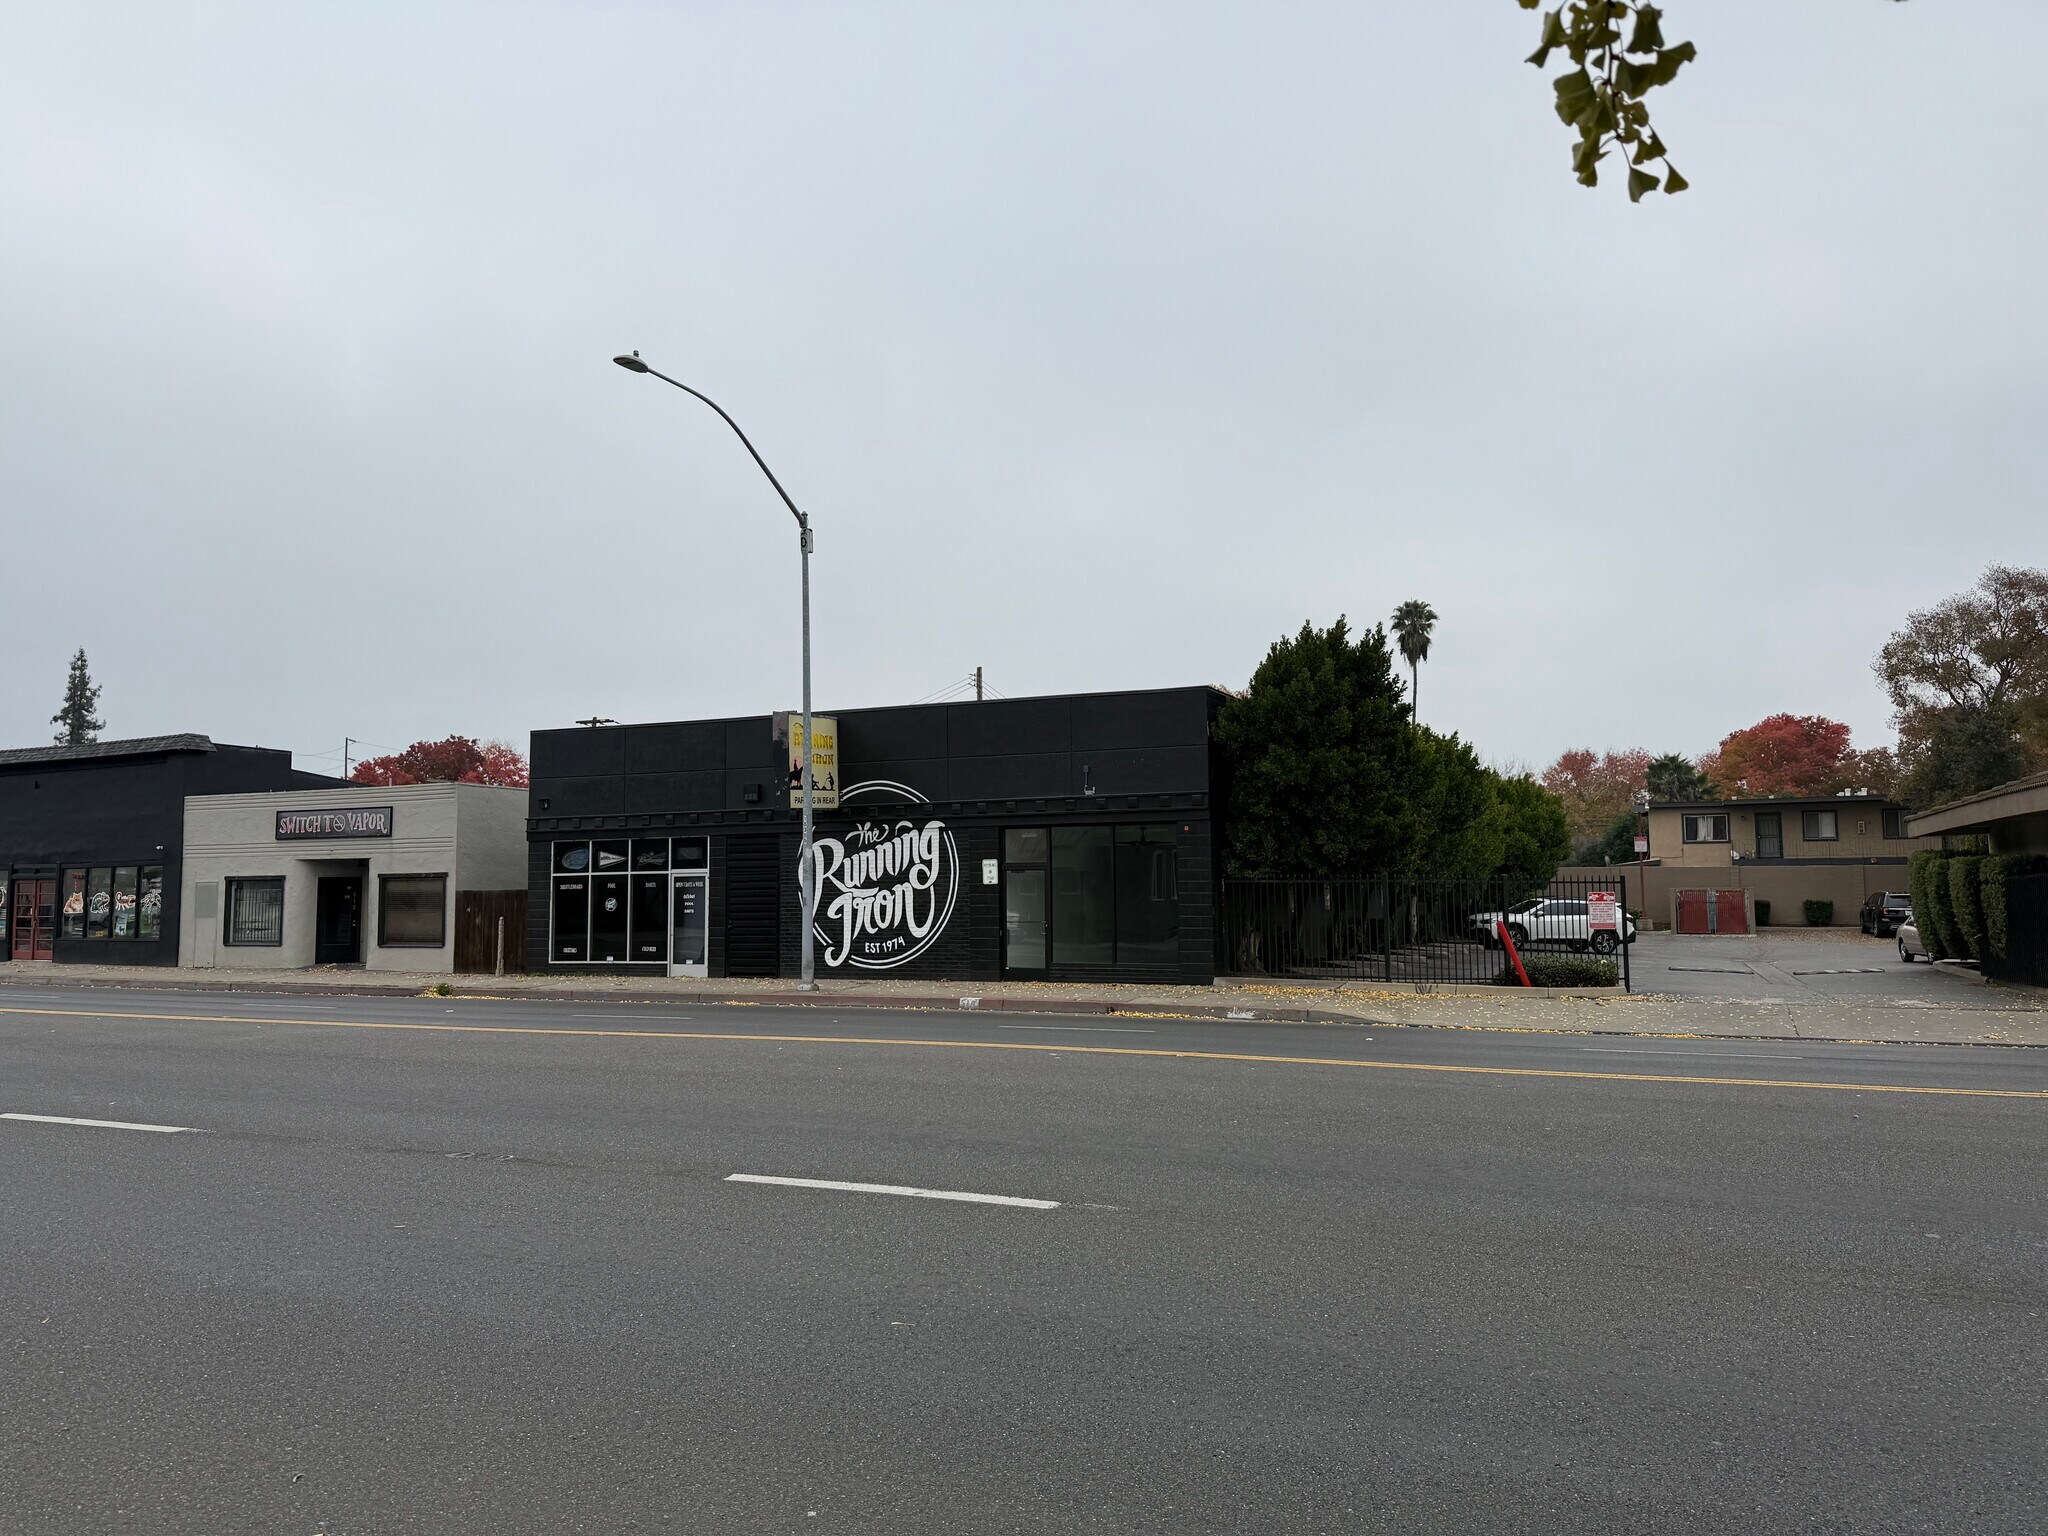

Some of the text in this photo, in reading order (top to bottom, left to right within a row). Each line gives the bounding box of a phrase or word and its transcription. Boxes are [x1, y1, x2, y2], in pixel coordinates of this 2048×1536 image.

[793, 732, 834, 749] RNING
[822, 797, 836, 805] REAR
[279, 815, 321, 834] SWITCH
[346, 811, 388, 834] VAPOR
[865, 935, 906, 953] EST 1974
